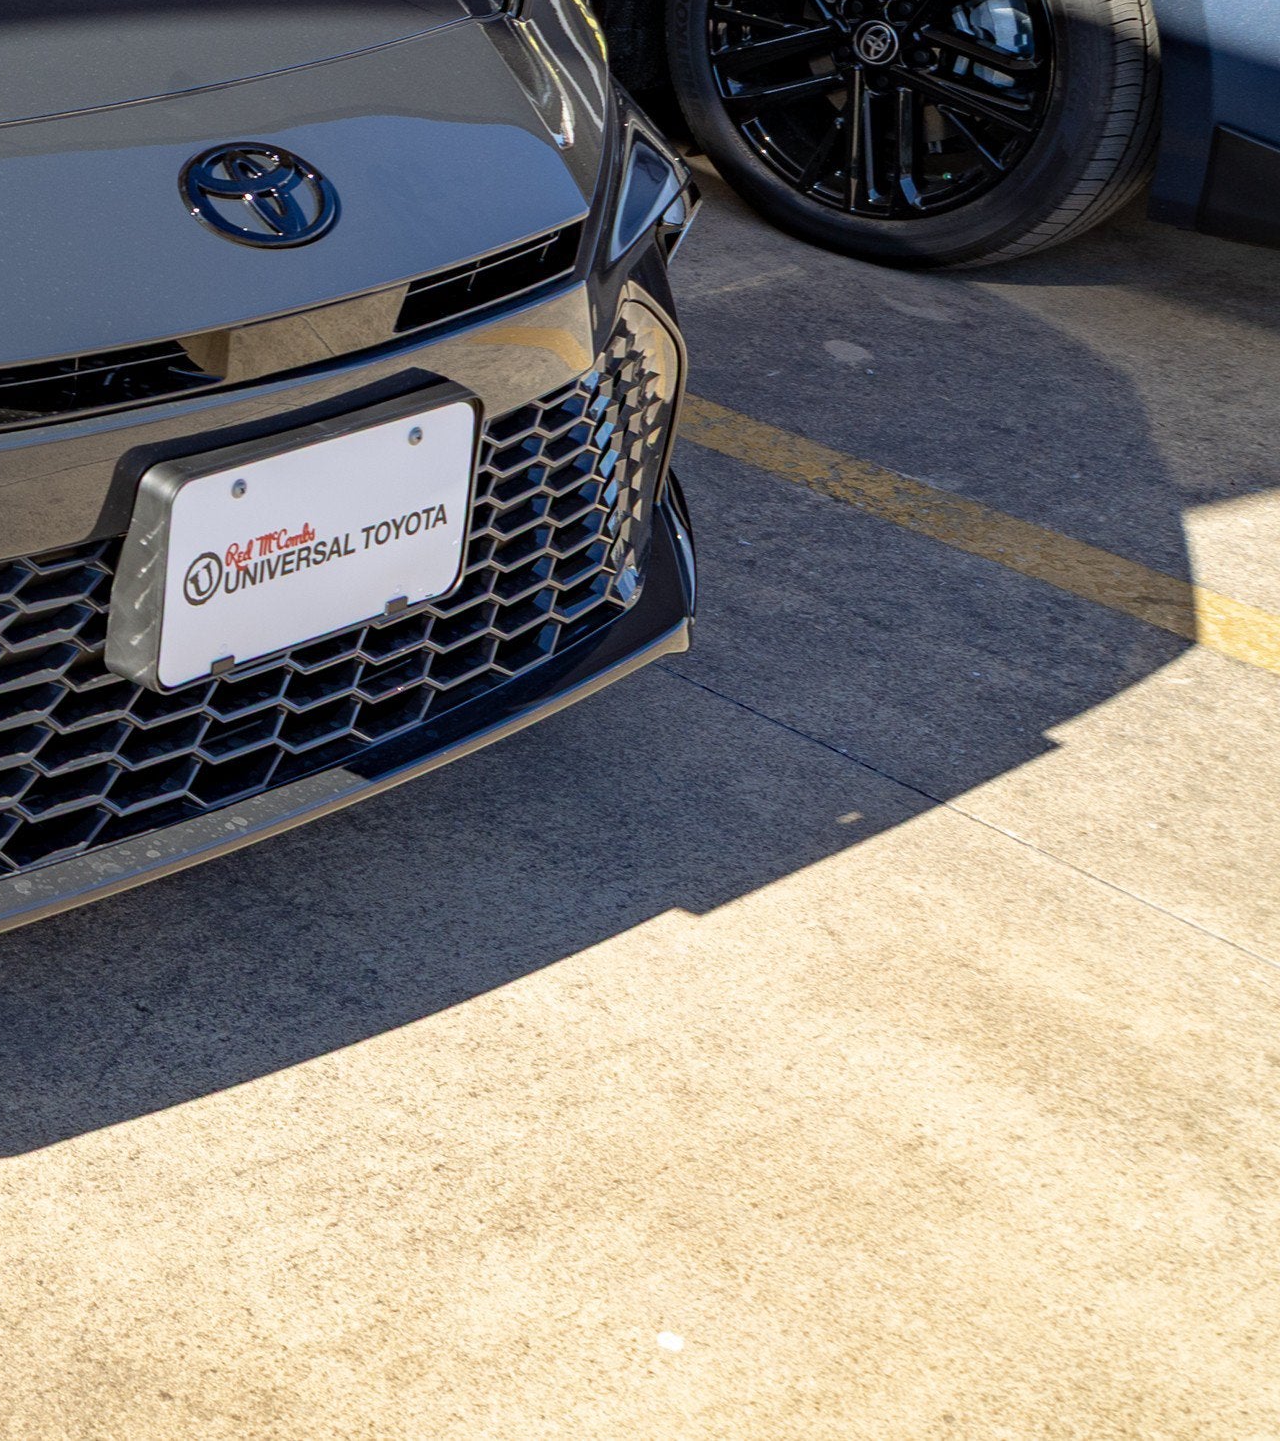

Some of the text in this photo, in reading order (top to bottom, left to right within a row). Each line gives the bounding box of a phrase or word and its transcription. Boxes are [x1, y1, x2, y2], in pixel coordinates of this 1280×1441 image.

[224, 503, 448, 594] UNIVERSAL TOYOTA
[225, 522, 316, 571] Red McCombs
